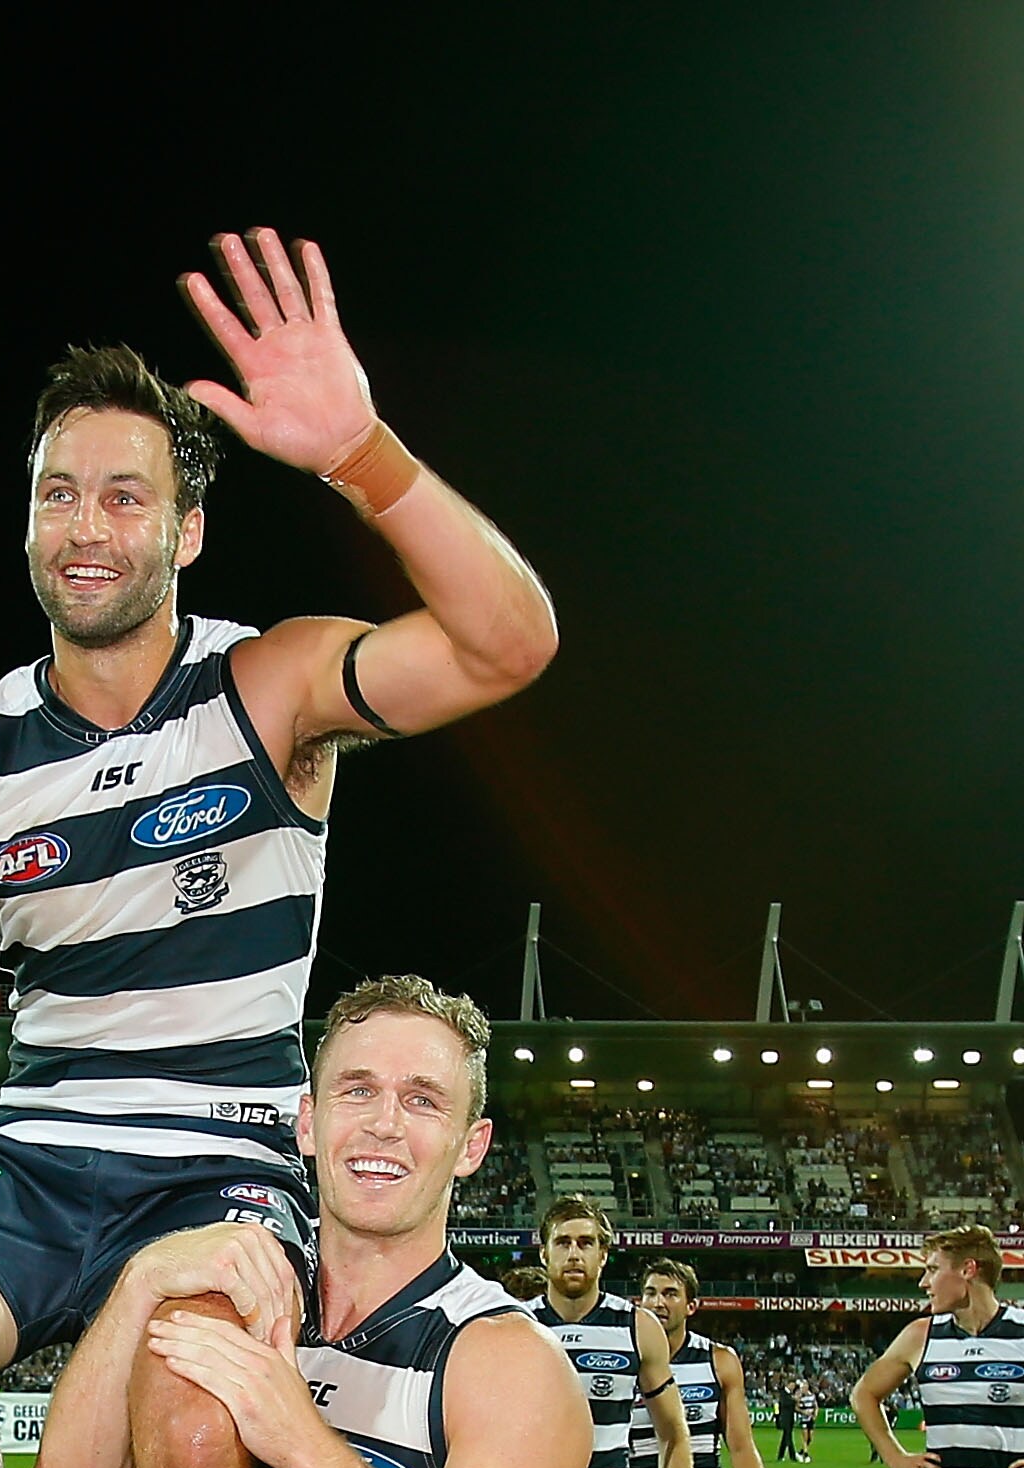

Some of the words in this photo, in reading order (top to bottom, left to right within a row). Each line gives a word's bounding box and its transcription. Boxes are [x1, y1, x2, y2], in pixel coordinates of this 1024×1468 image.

[91, 761, 143, 792] ISC
[154, 794, 227, 841] Ford
[242, 1107, 277, 1125] ISC
[225, 1208, 284, 1233] ISC
[450, 1231, 520, 1245] Advertiser
[627, 1232, 663, 1245] TIRE
[671, 1232, 713, 1246] Driving
[718, 1233, 782, 1244] Tomorrow
[819, 1233, 880, 1247] NEXEN
[882, 1233, 923, 1246] TIRE
[809, 1249, 926, 1265] SIMON
[755, 1298, 824, 1311] SIMONDS
[852, 1298, 920, 1311] SIMONDS
[561, 1334, 583, 1342] ISC
[586, 1353, 621, 1368] Ford
[929, 1367, 957, 1377] AFL
[984, 1365, 1016, 1377] Ford
[308, 1380, 338, 1407] SC
[13, 1405, 47, 1418] GEELO
[13, 1419, 44, 1441] CA
